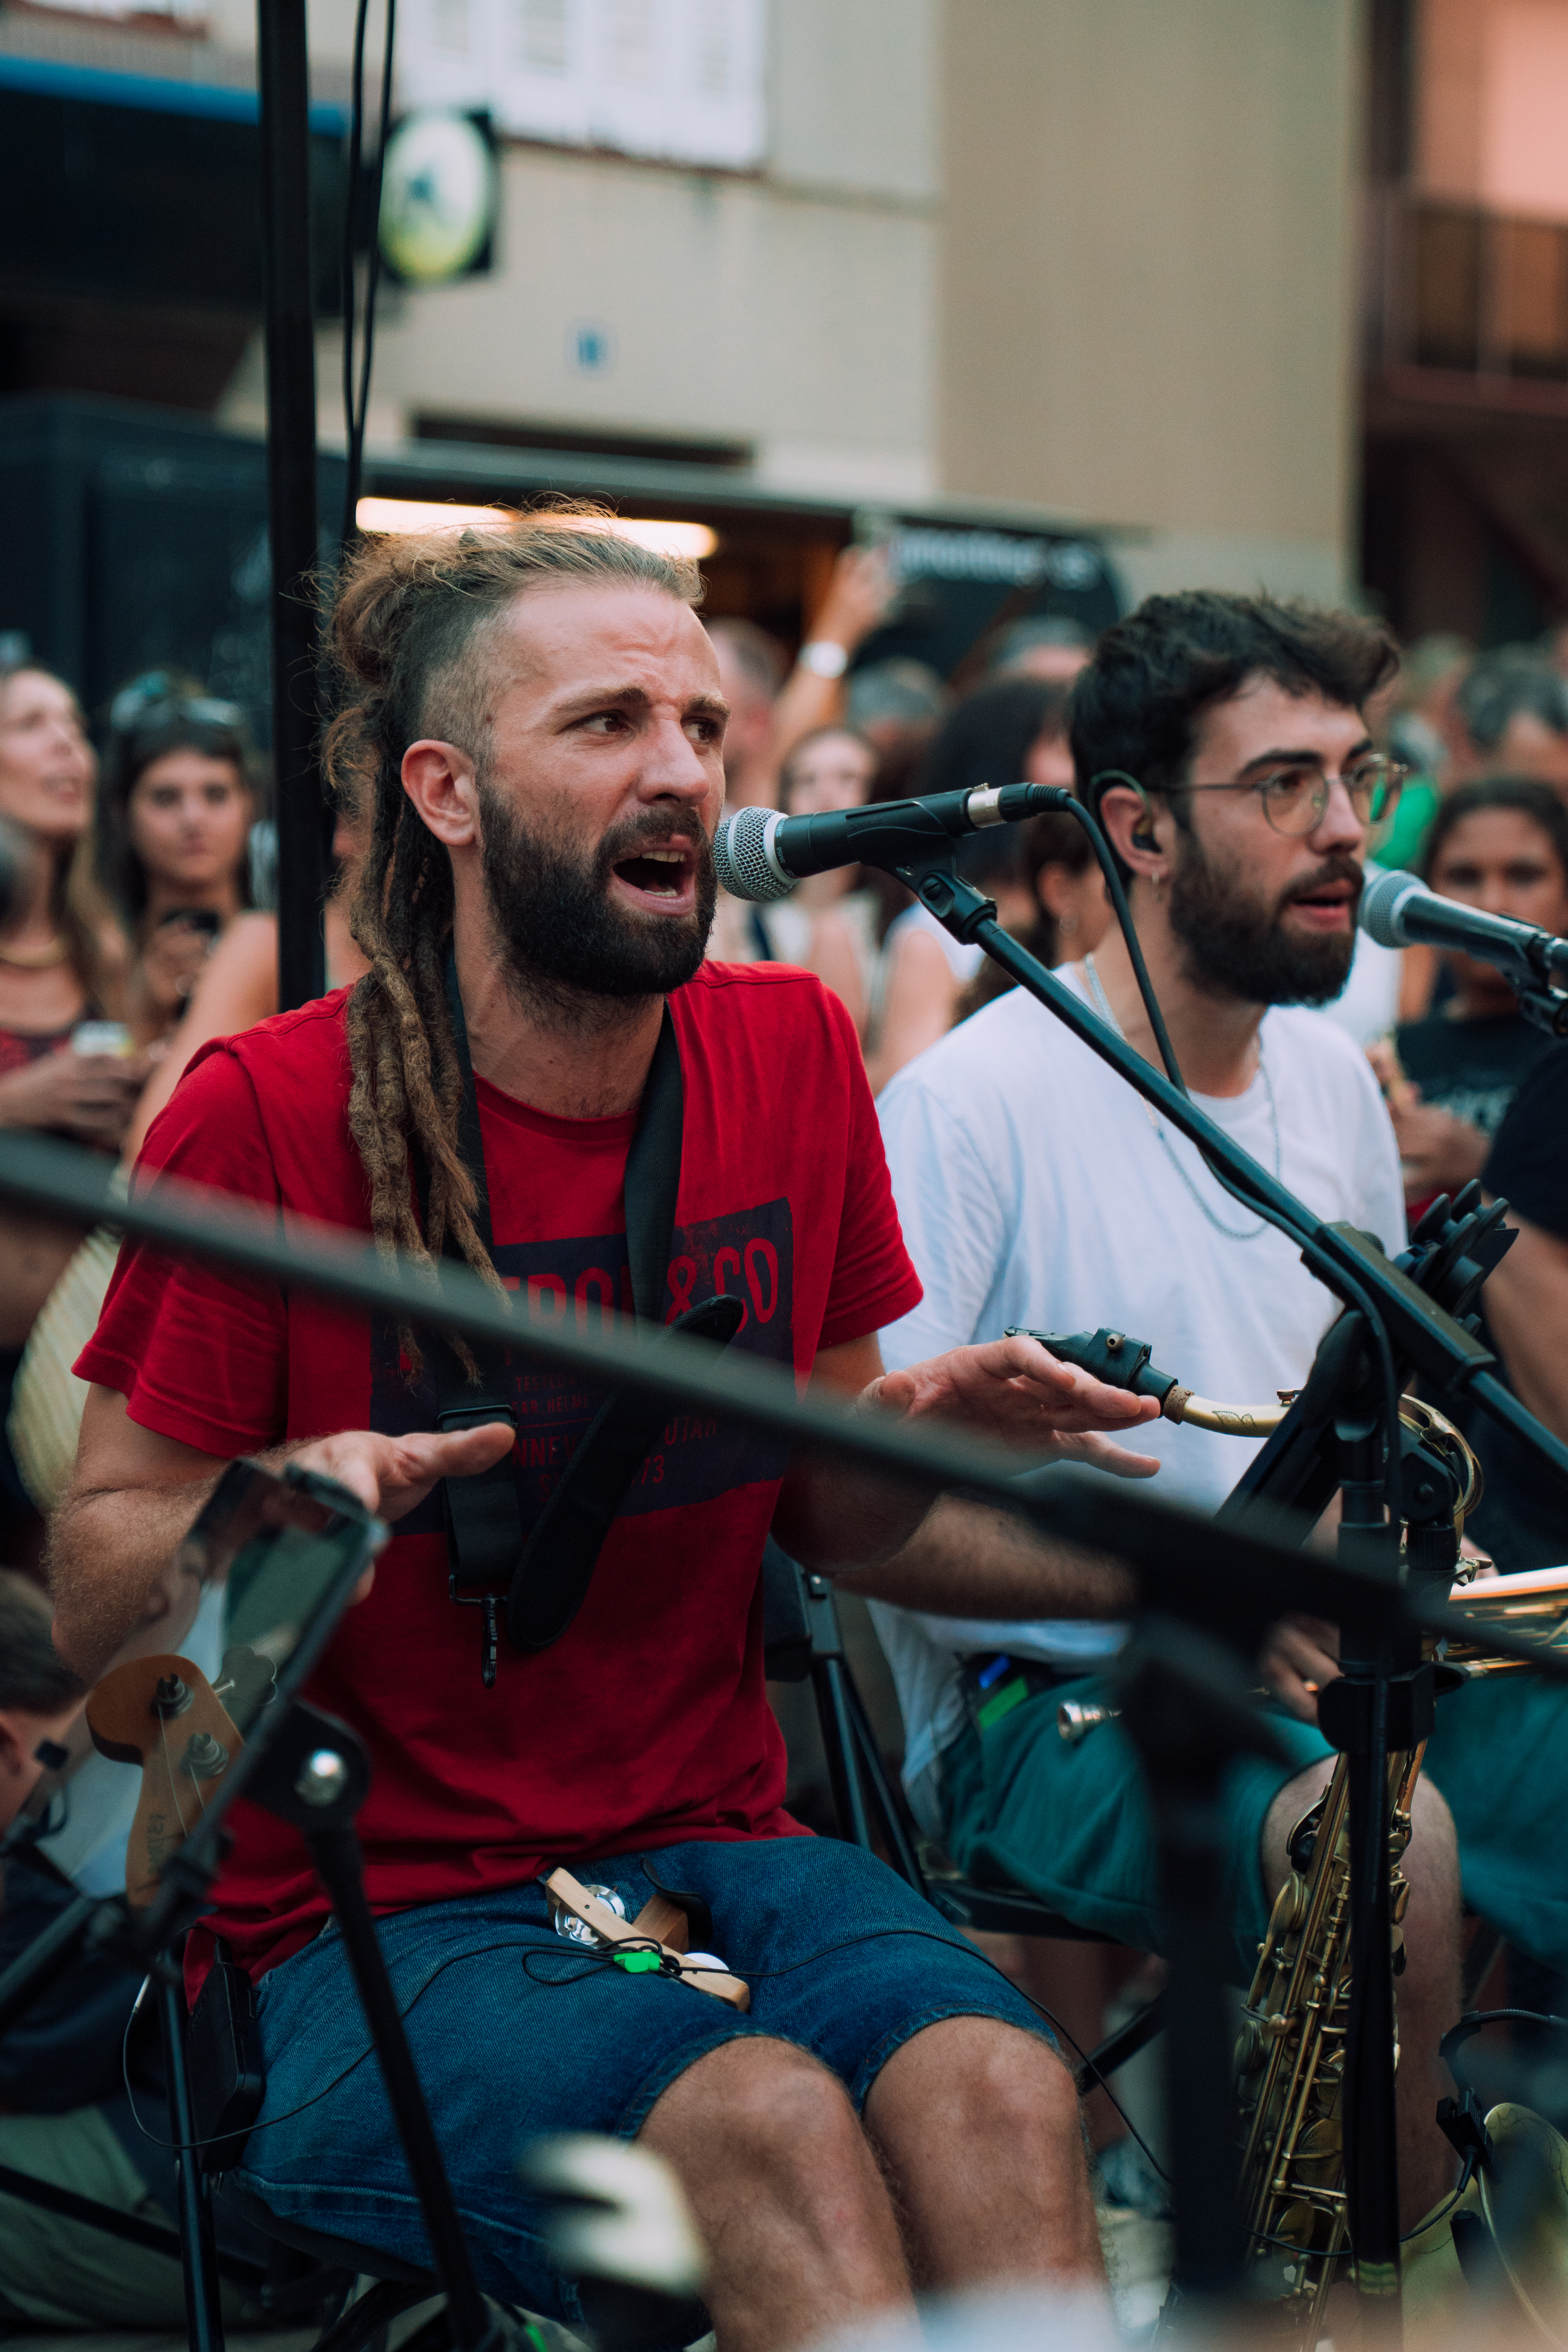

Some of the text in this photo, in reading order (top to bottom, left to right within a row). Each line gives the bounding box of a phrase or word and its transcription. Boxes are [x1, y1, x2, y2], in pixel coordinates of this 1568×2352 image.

[777, 847, 786, 863] SM58
[515, 1372, 565, 1392] TESTED
[664, 1413, 717, 1446] UTAH
